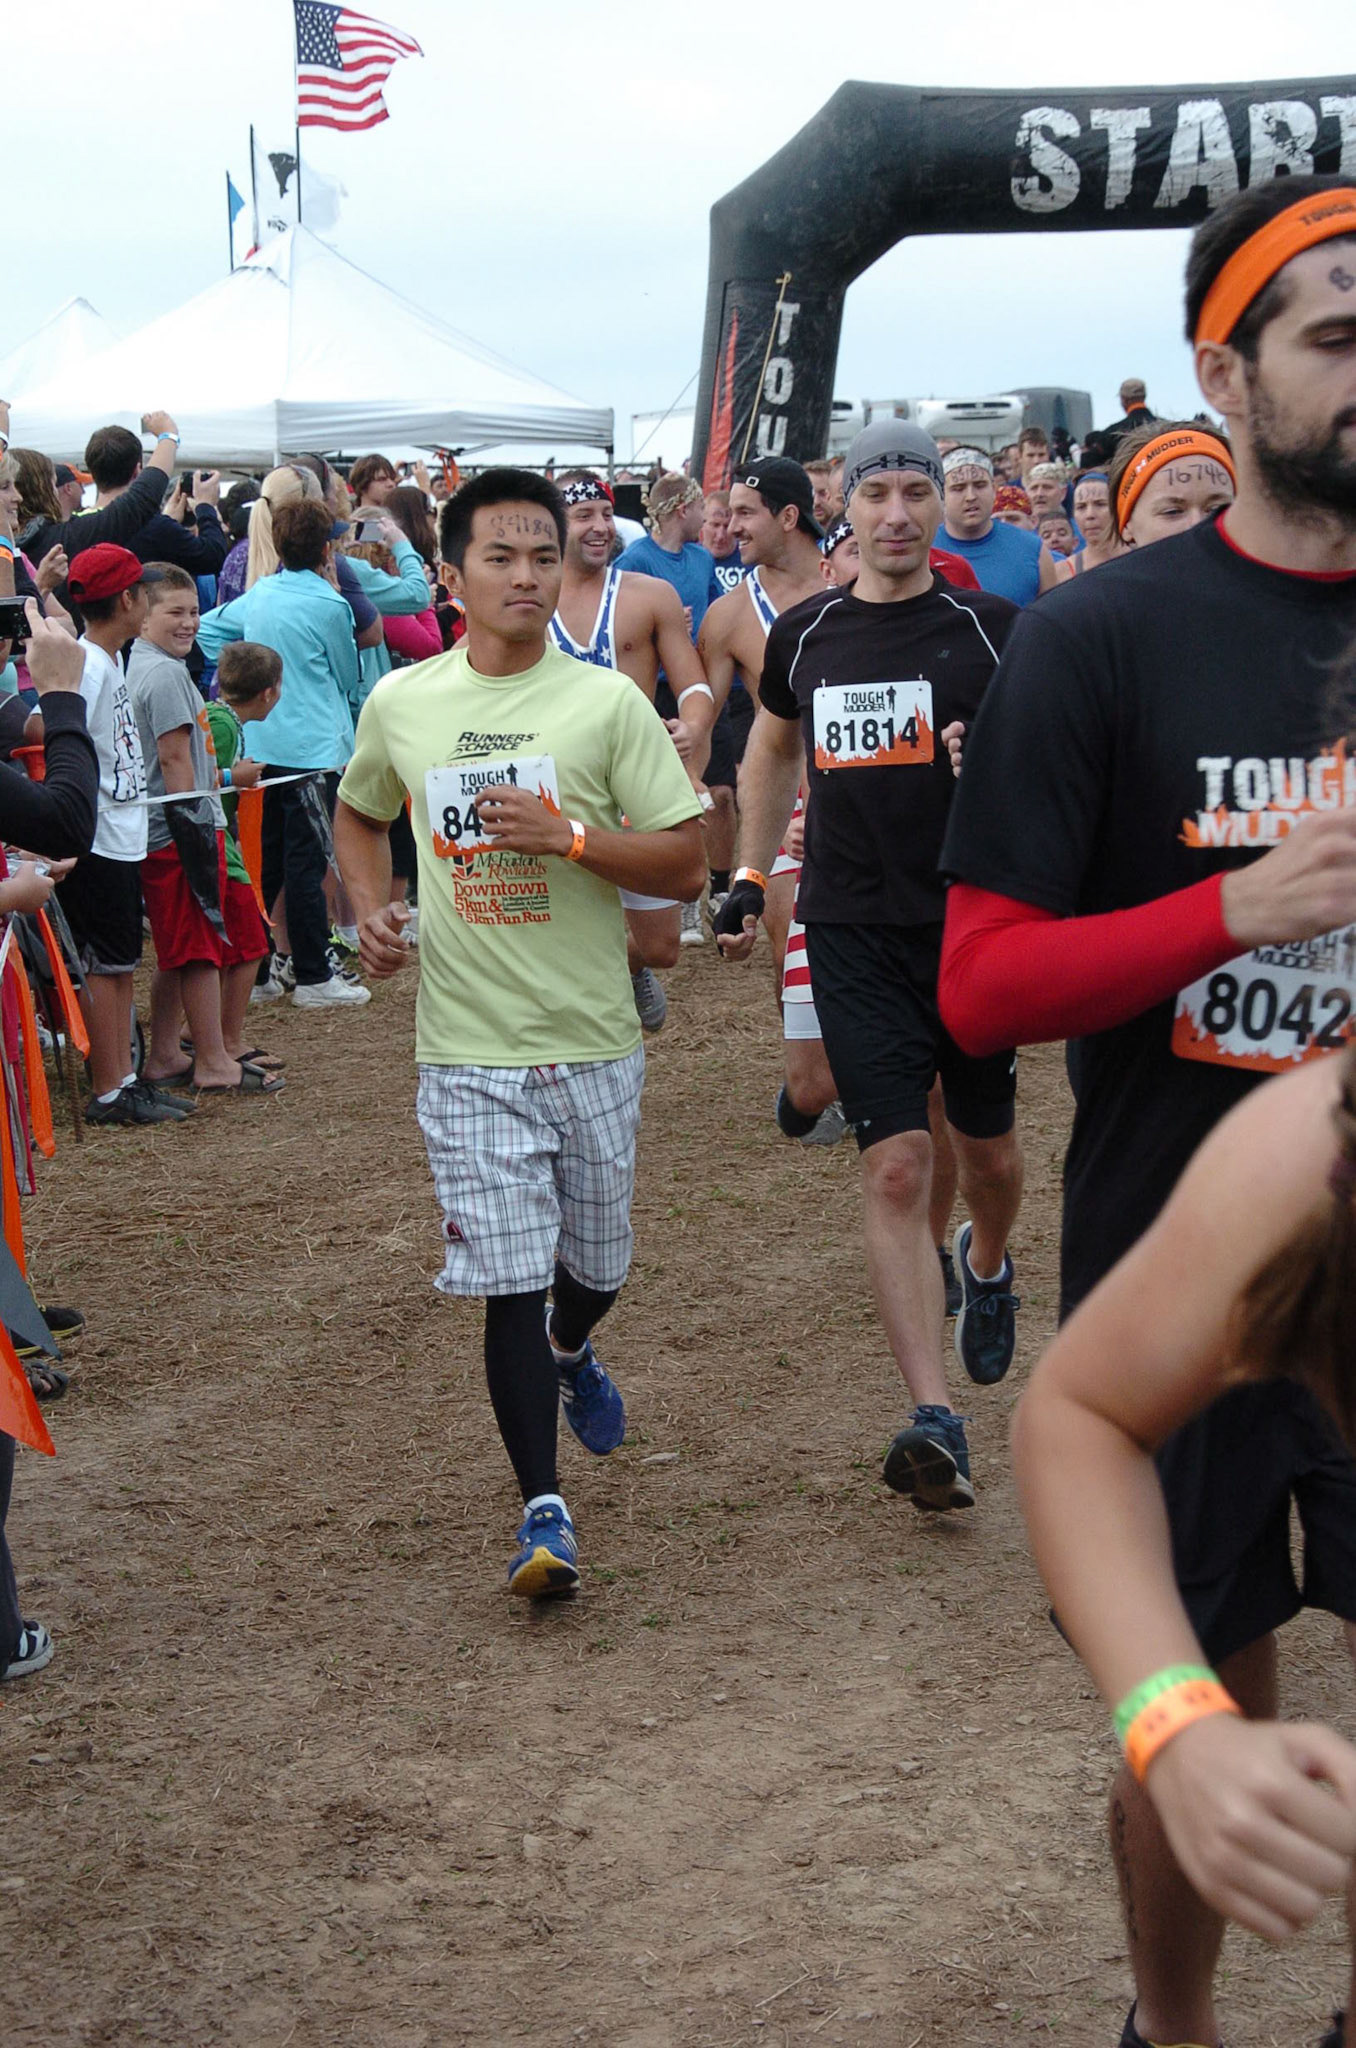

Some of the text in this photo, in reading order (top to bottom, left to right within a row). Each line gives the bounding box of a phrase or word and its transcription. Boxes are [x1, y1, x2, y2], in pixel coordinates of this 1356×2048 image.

[1147, 436, 1195, 462] MUDDER
[843, 691, 885, 706] TOUGH
[843, 703, 886, 713] MUDDER
[826, 716, 919, 753] 81814
[465, 742, 521, 752] CHOICE
[459, 770, 505, 787] TOUGH
[454, 880, 549, 897] Downtown
[496, 912, 521, 925] Fun
[522, 911, 551, 923] Run
